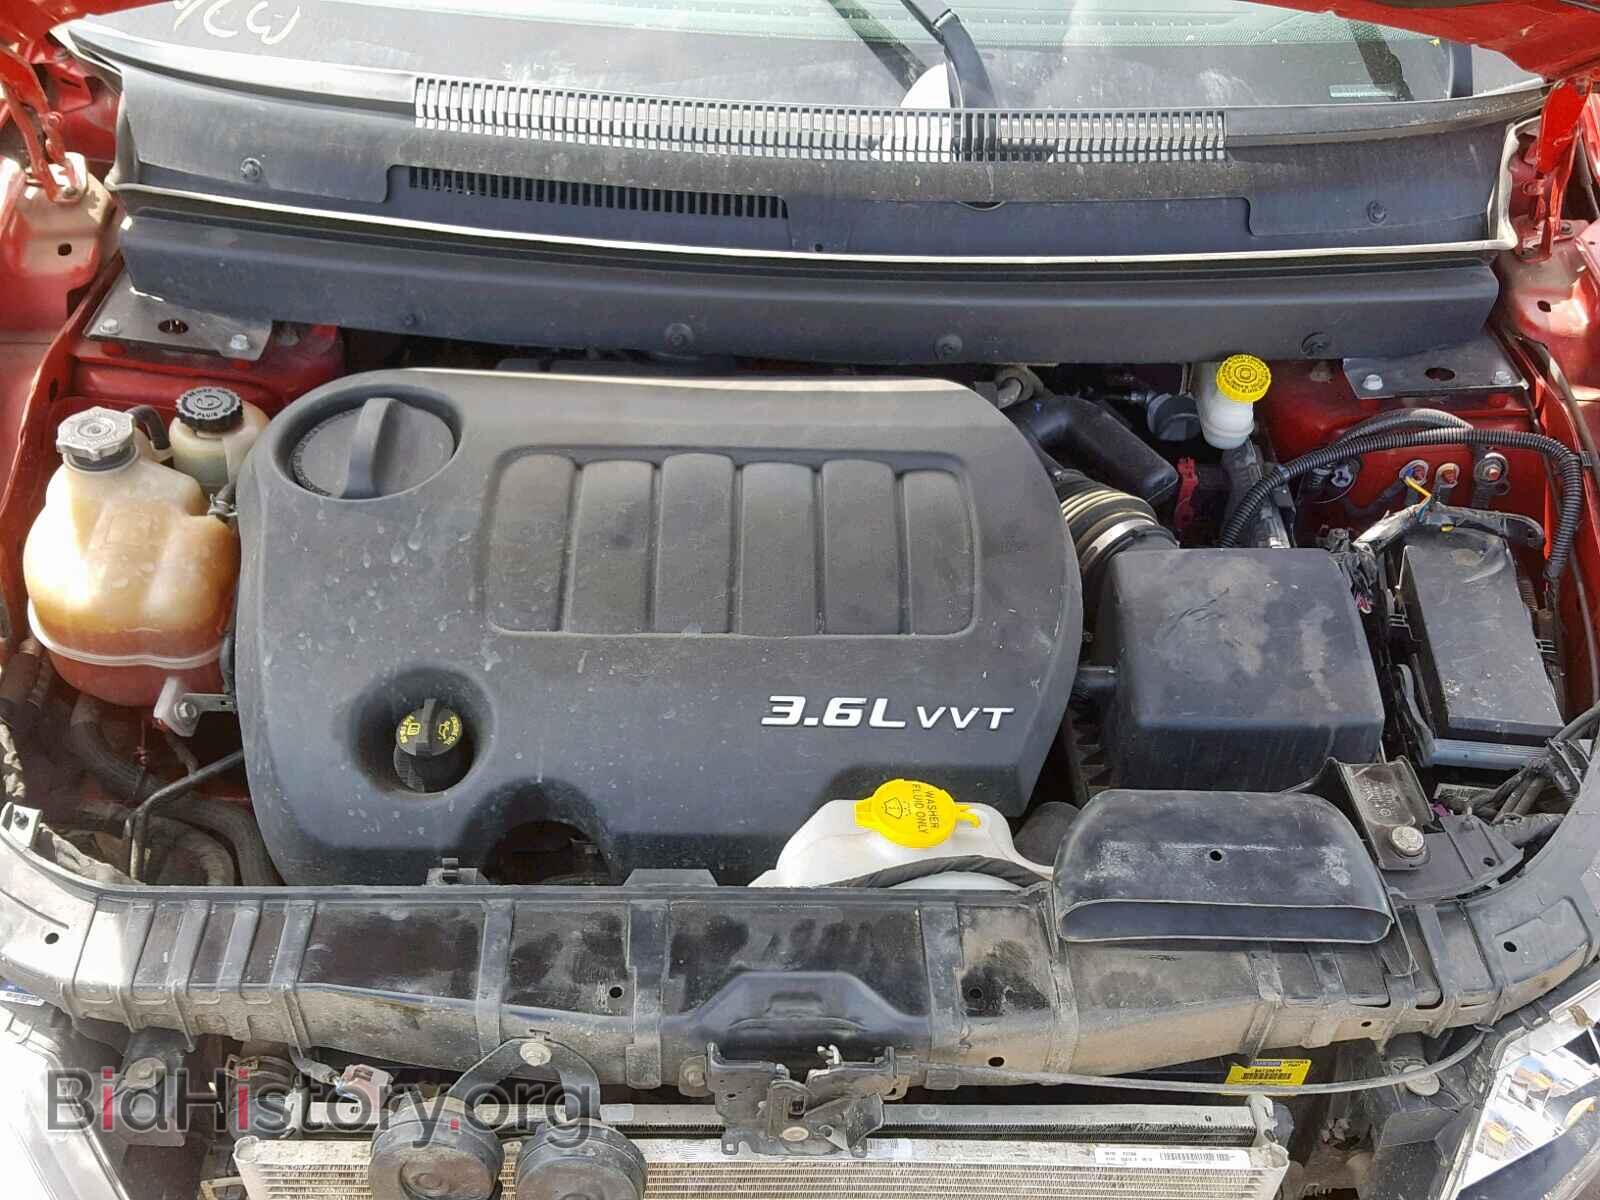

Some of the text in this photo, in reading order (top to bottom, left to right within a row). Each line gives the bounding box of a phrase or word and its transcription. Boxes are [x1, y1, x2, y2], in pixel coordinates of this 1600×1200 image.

[760, 695, 1015, 730] 3.6L VVT
[911, 783, 929, 835] FLUID ONLY
[925, 789, 940, 830] WASHER
